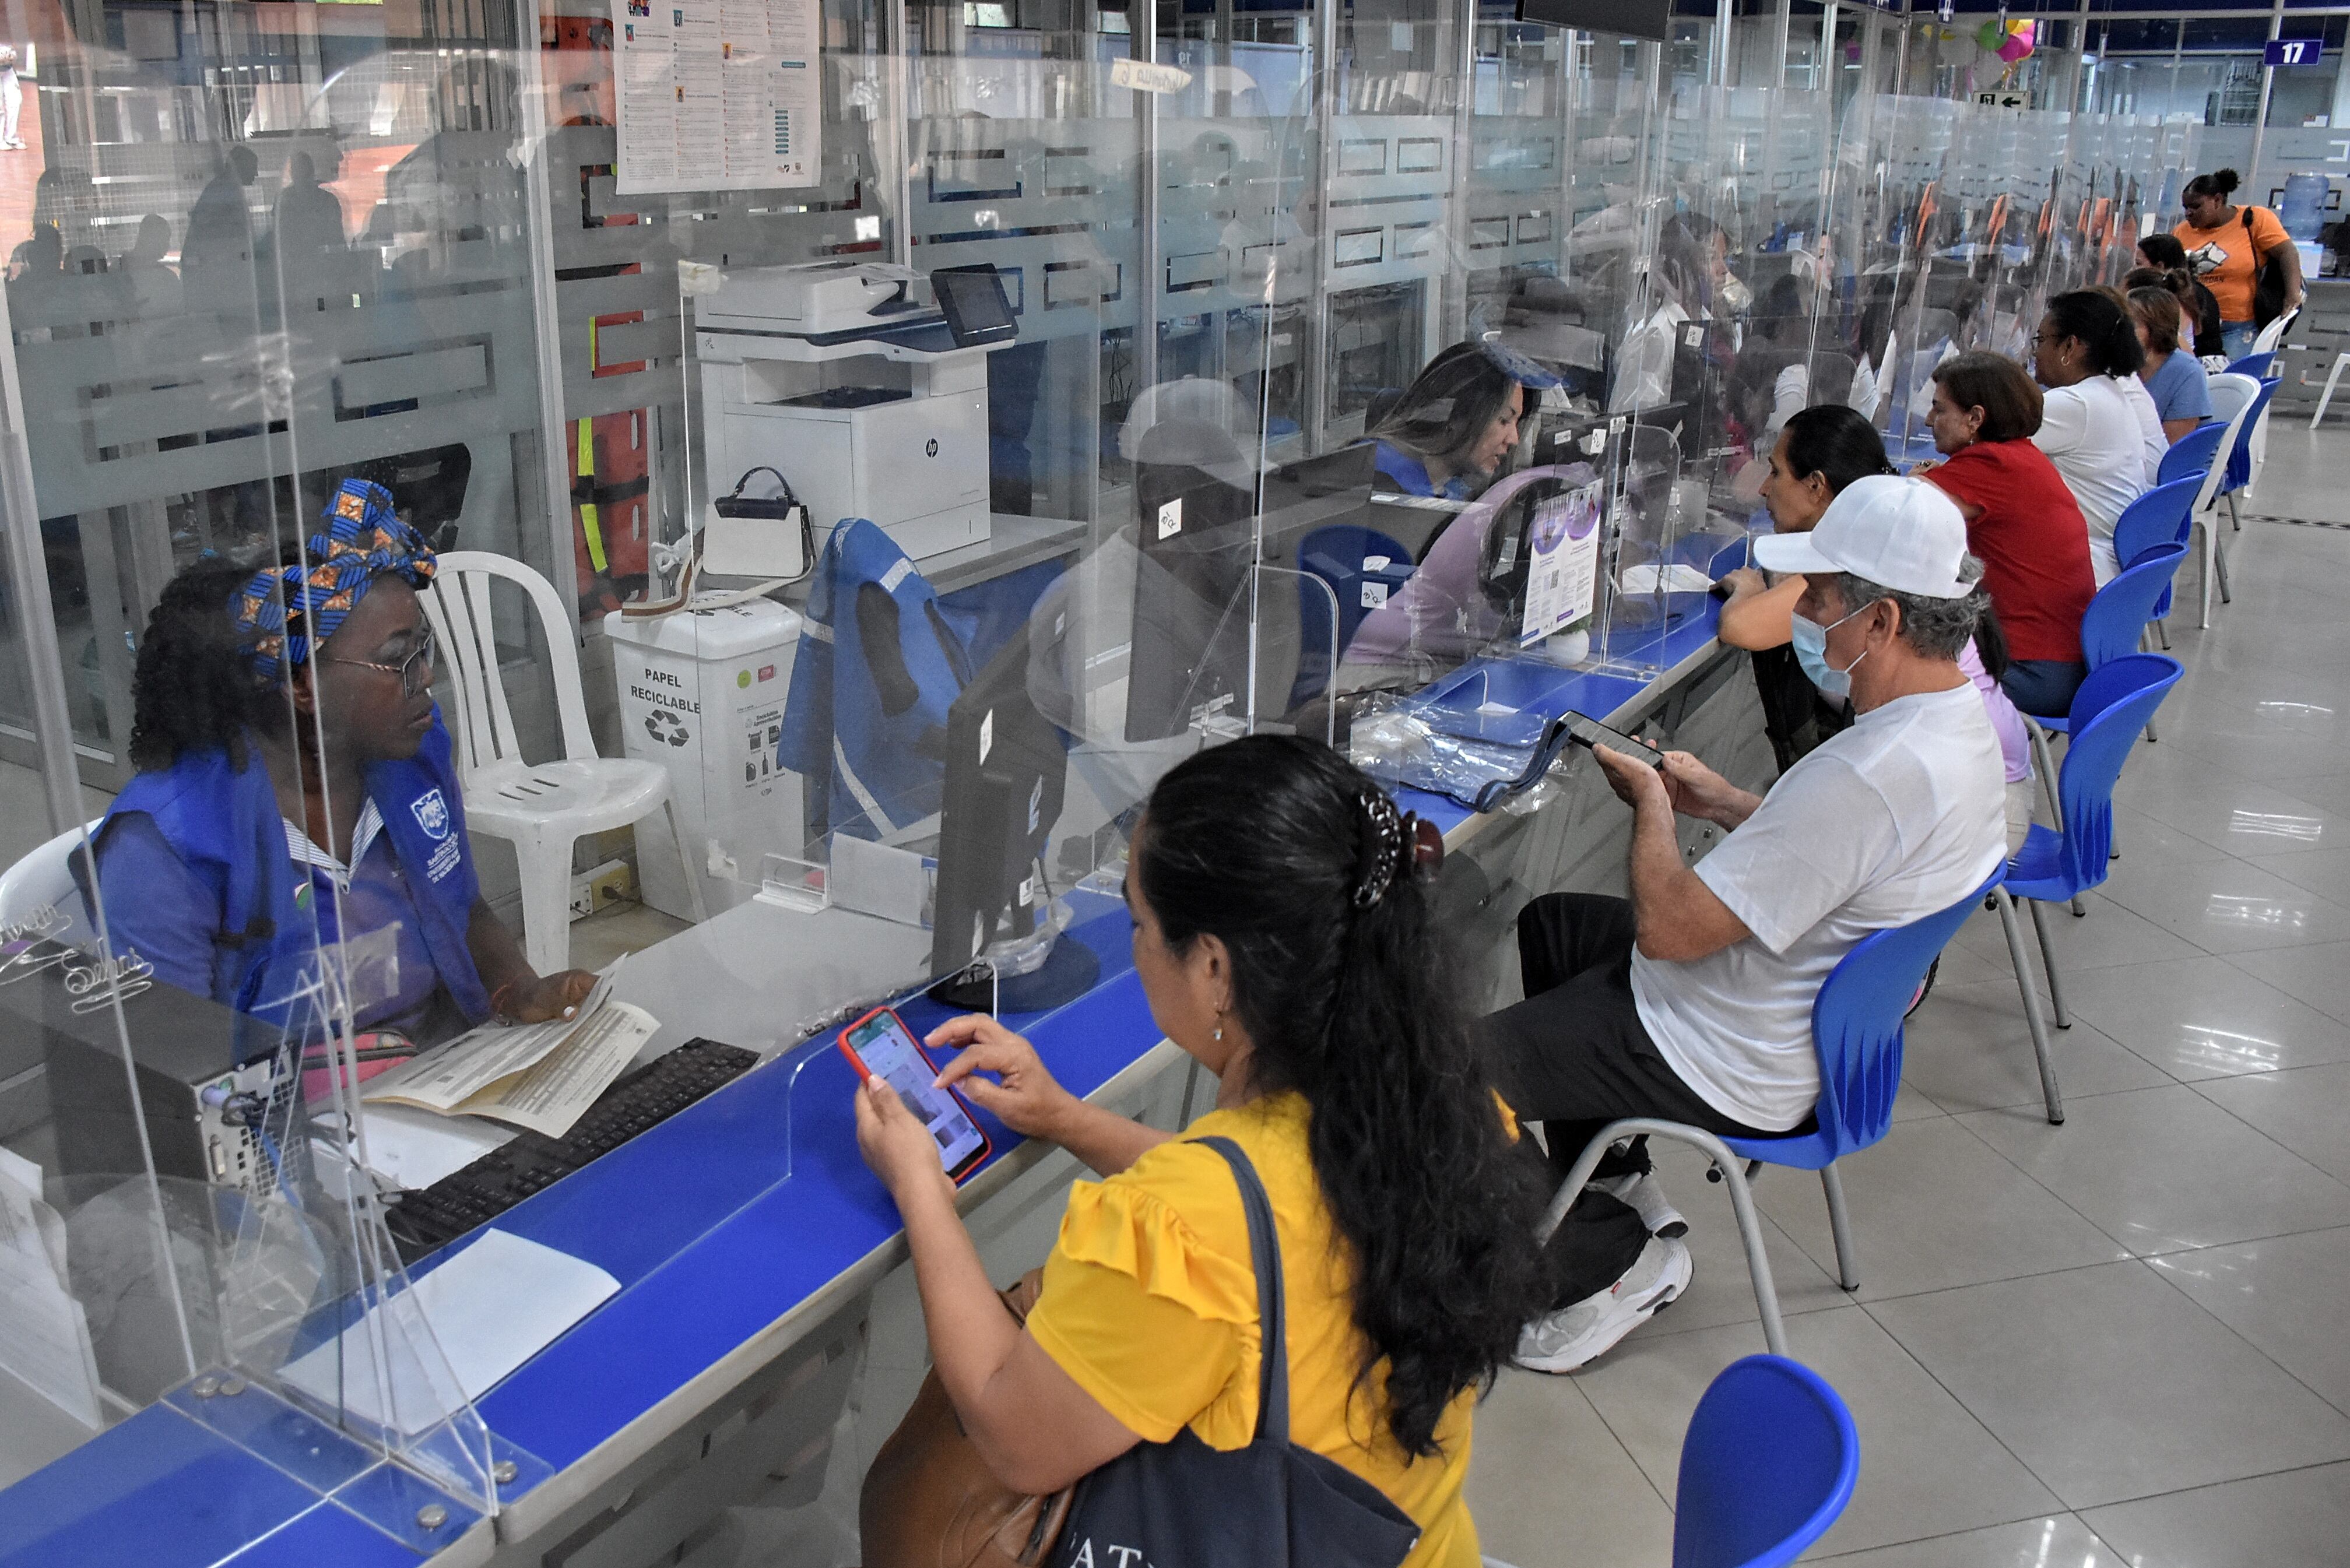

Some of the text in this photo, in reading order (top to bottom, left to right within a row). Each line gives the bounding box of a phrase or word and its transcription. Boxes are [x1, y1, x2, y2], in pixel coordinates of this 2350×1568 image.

[2282, 42, 2305, 64] 17
[928, 438, 937, 458] hp
[645, 668, 682, 688] PAPEL
[631, 685, 700, 714] RECICLABLE
